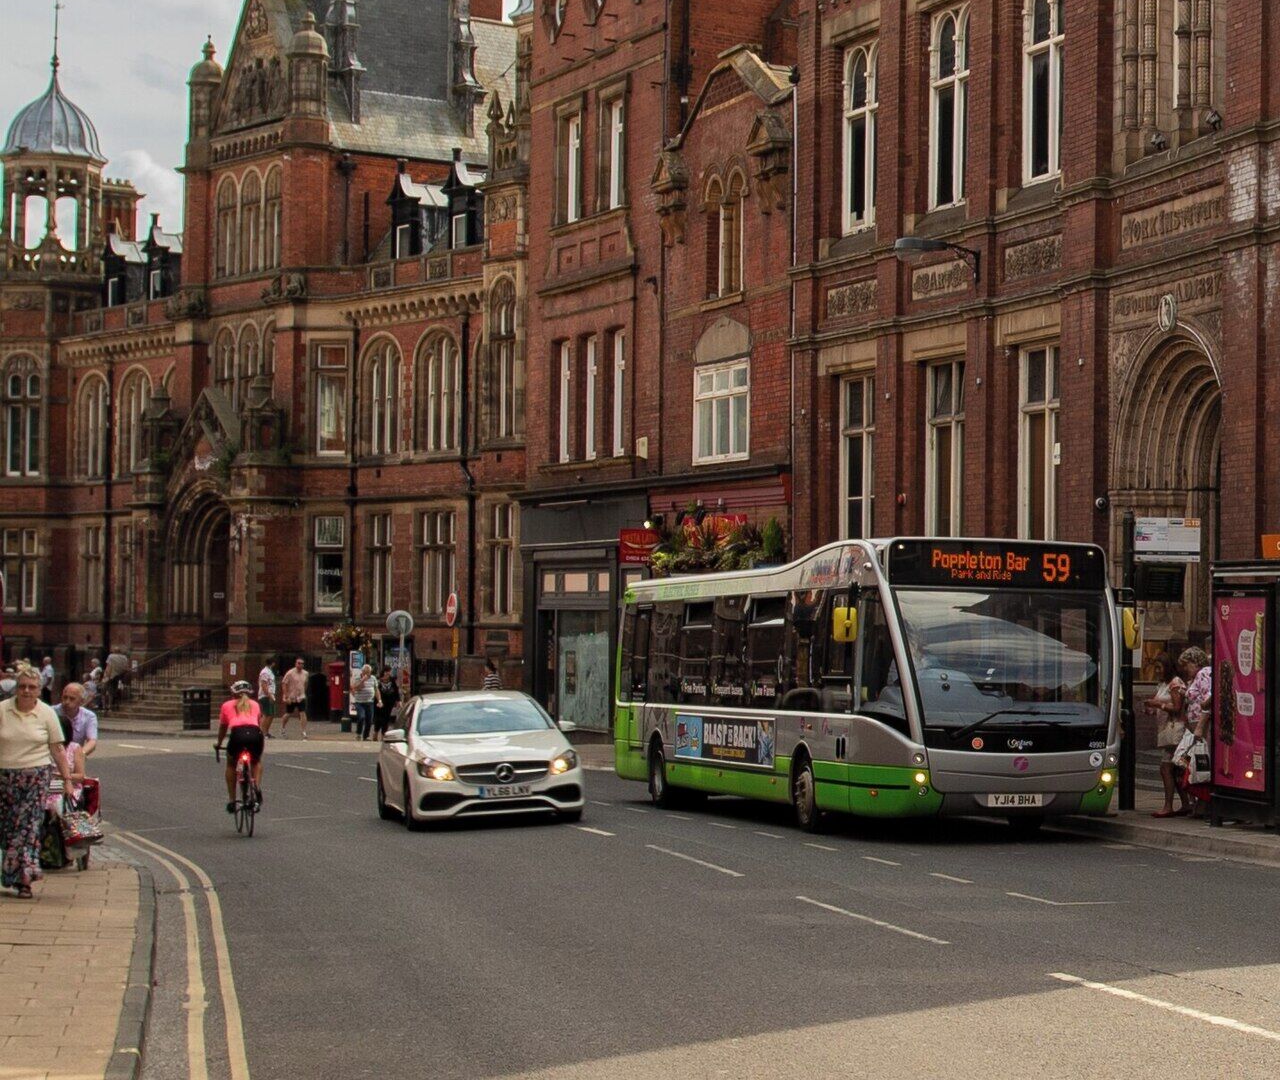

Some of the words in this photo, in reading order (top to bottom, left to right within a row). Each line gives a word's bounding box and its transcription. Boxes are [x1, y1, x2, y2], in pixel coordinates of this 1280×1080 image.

[931, 549, 1001, 570] Poppleton
[1006, 551, 1030, 571] Bar
[1042, 553, 1071, 582] 59
[951, 569, 973, 579] Park
[975, 570, 992, 580] and
[704, 723, 728, 746] BLAST
[733, 724, 757, 749] BACK!
[1018, 794, 1036, 805] BHA
